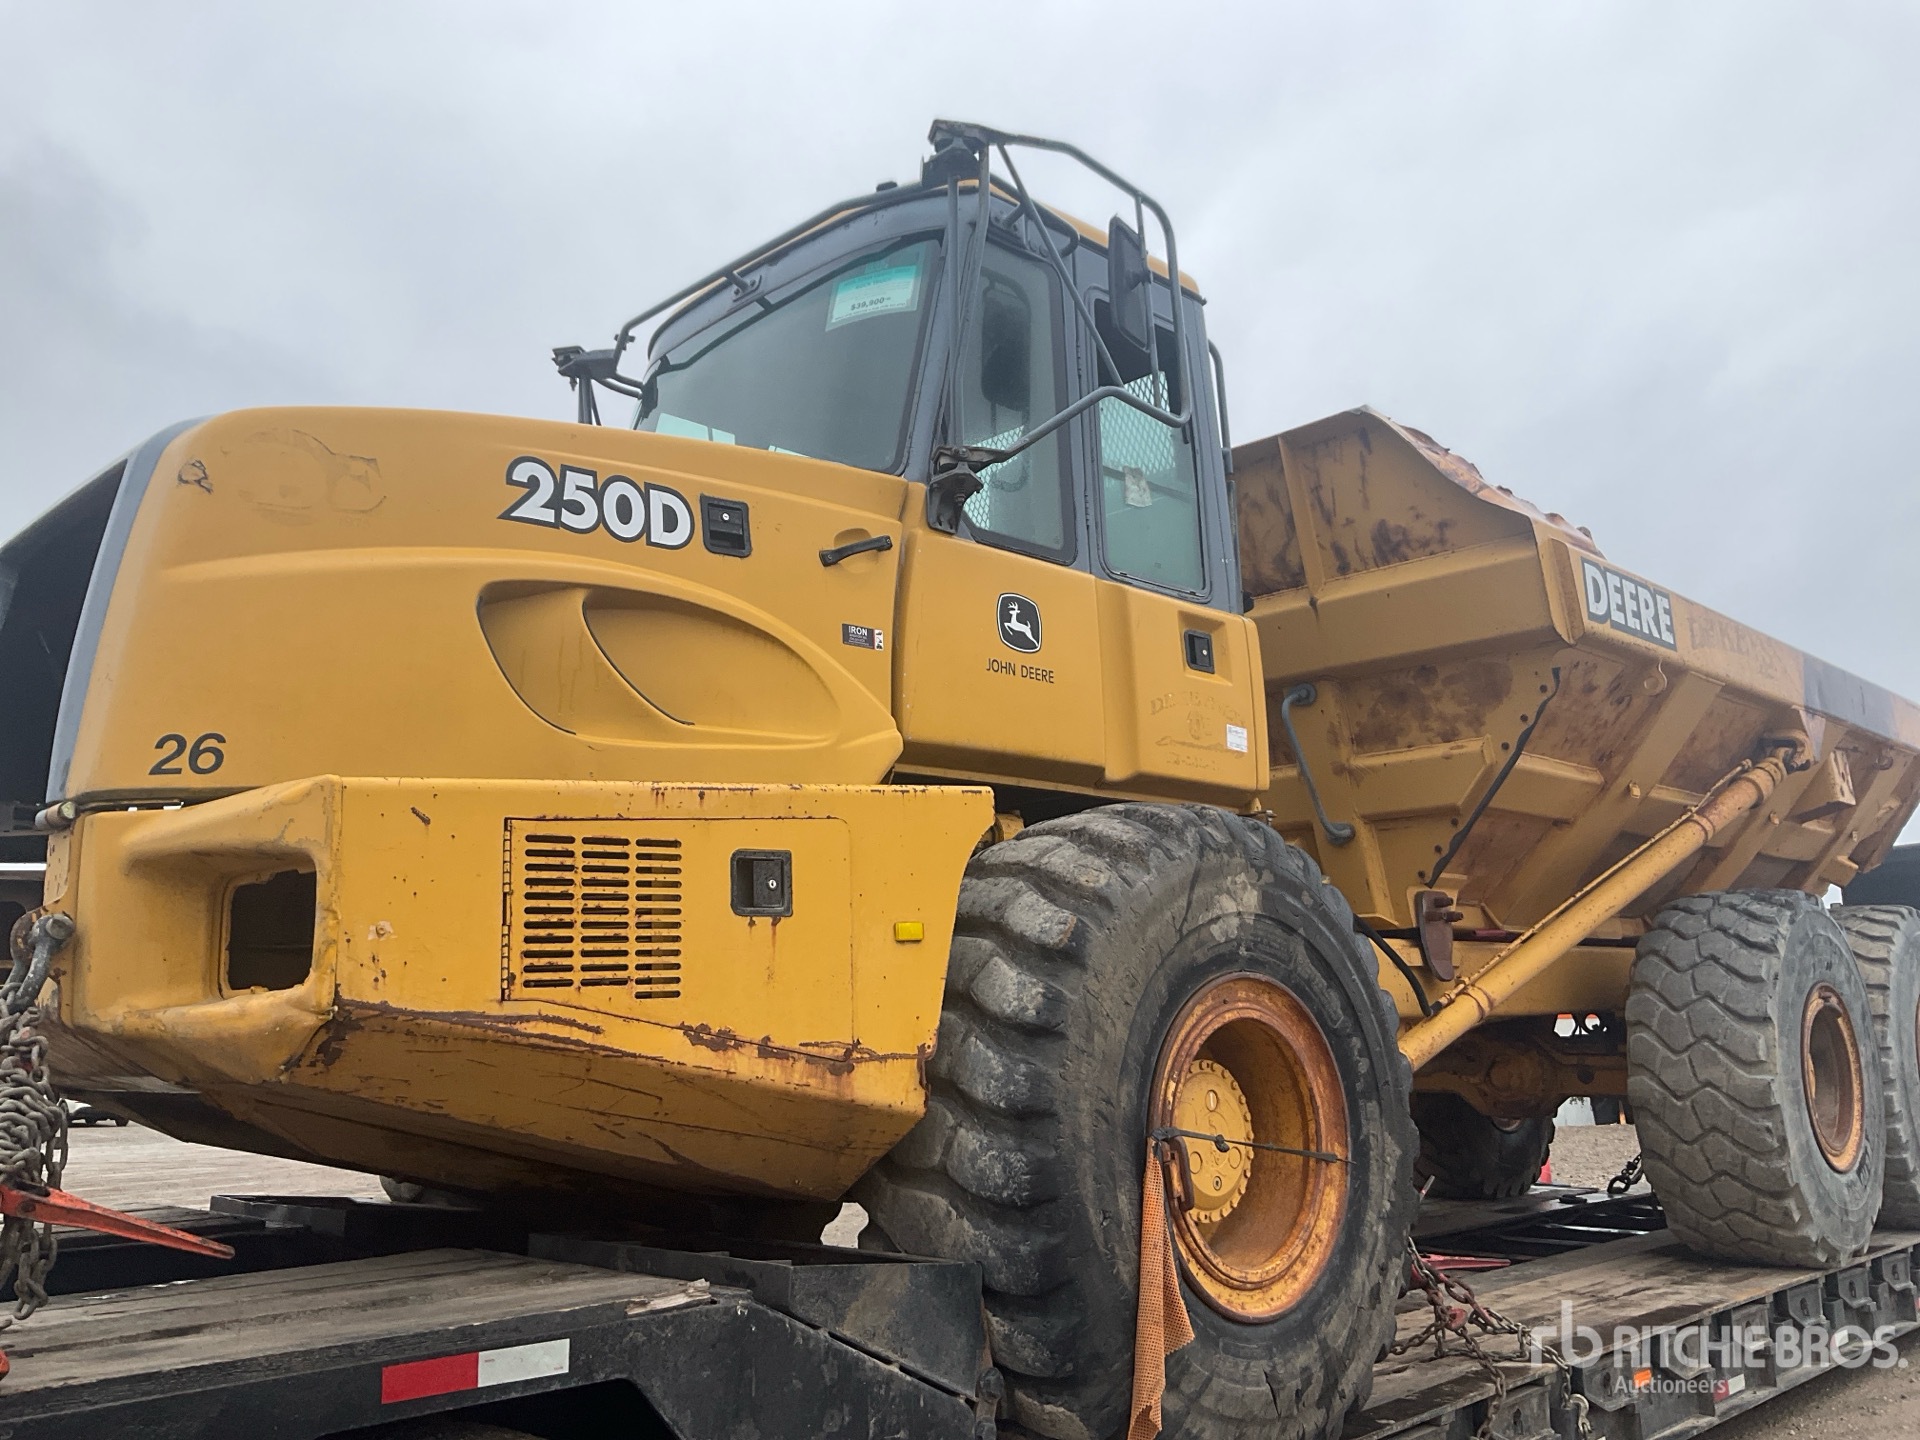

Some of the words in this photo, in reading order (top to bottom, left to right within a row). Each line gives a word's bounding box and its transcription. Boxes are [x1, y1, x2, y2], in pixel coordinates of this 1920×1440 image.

[497, 455, 695, 550] 250D
[1582, 557, 1677, 651] DEERE
[848, 626, 867, 636] IRON
[986, 658, 1016, 676] JOHN
[1020, 664, 1054, 684] DEERE
[148, 732, 227, 776] 26
